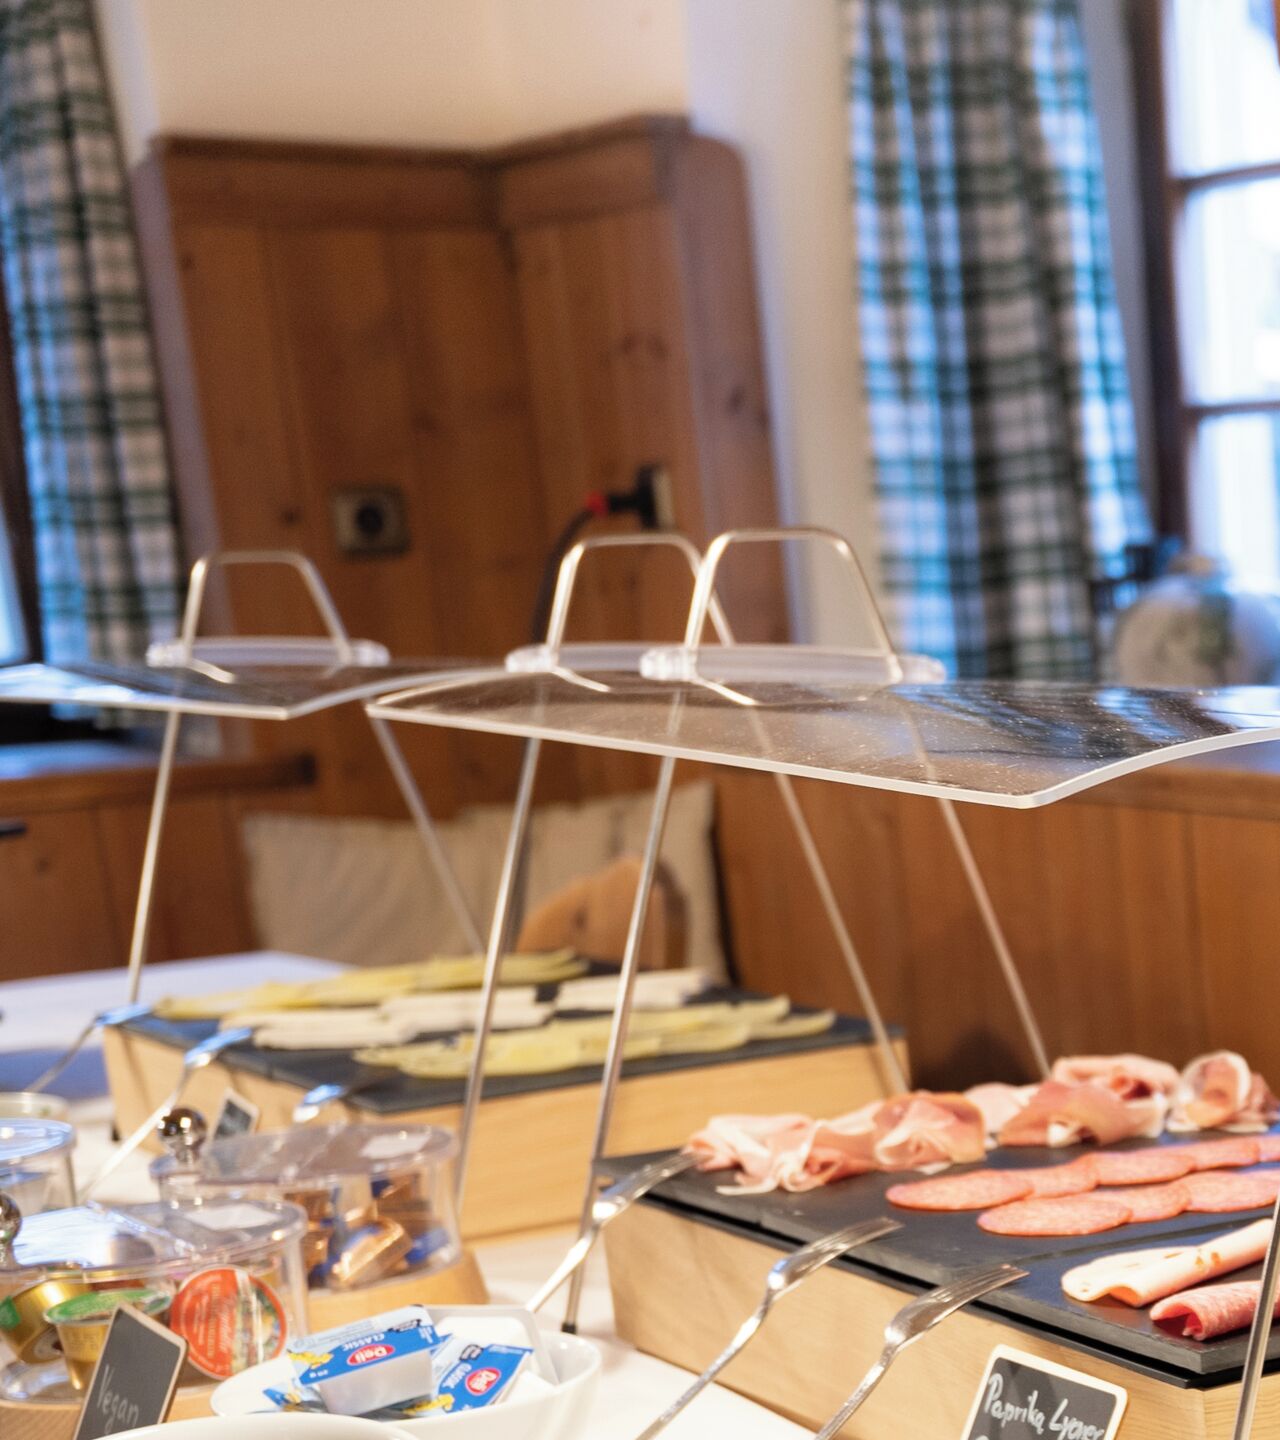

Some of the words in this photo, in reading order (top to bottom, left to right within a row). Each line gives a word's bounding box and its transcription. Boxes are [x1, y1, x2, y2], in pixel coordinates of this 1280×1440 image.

[340, 1333, 386, 1351] CLASSIC
[355, 1345, 389, 1364] Deli
[97, 1363, 139, 1435] Vegan
[983, 1372, 1046, 1435] Paprika
